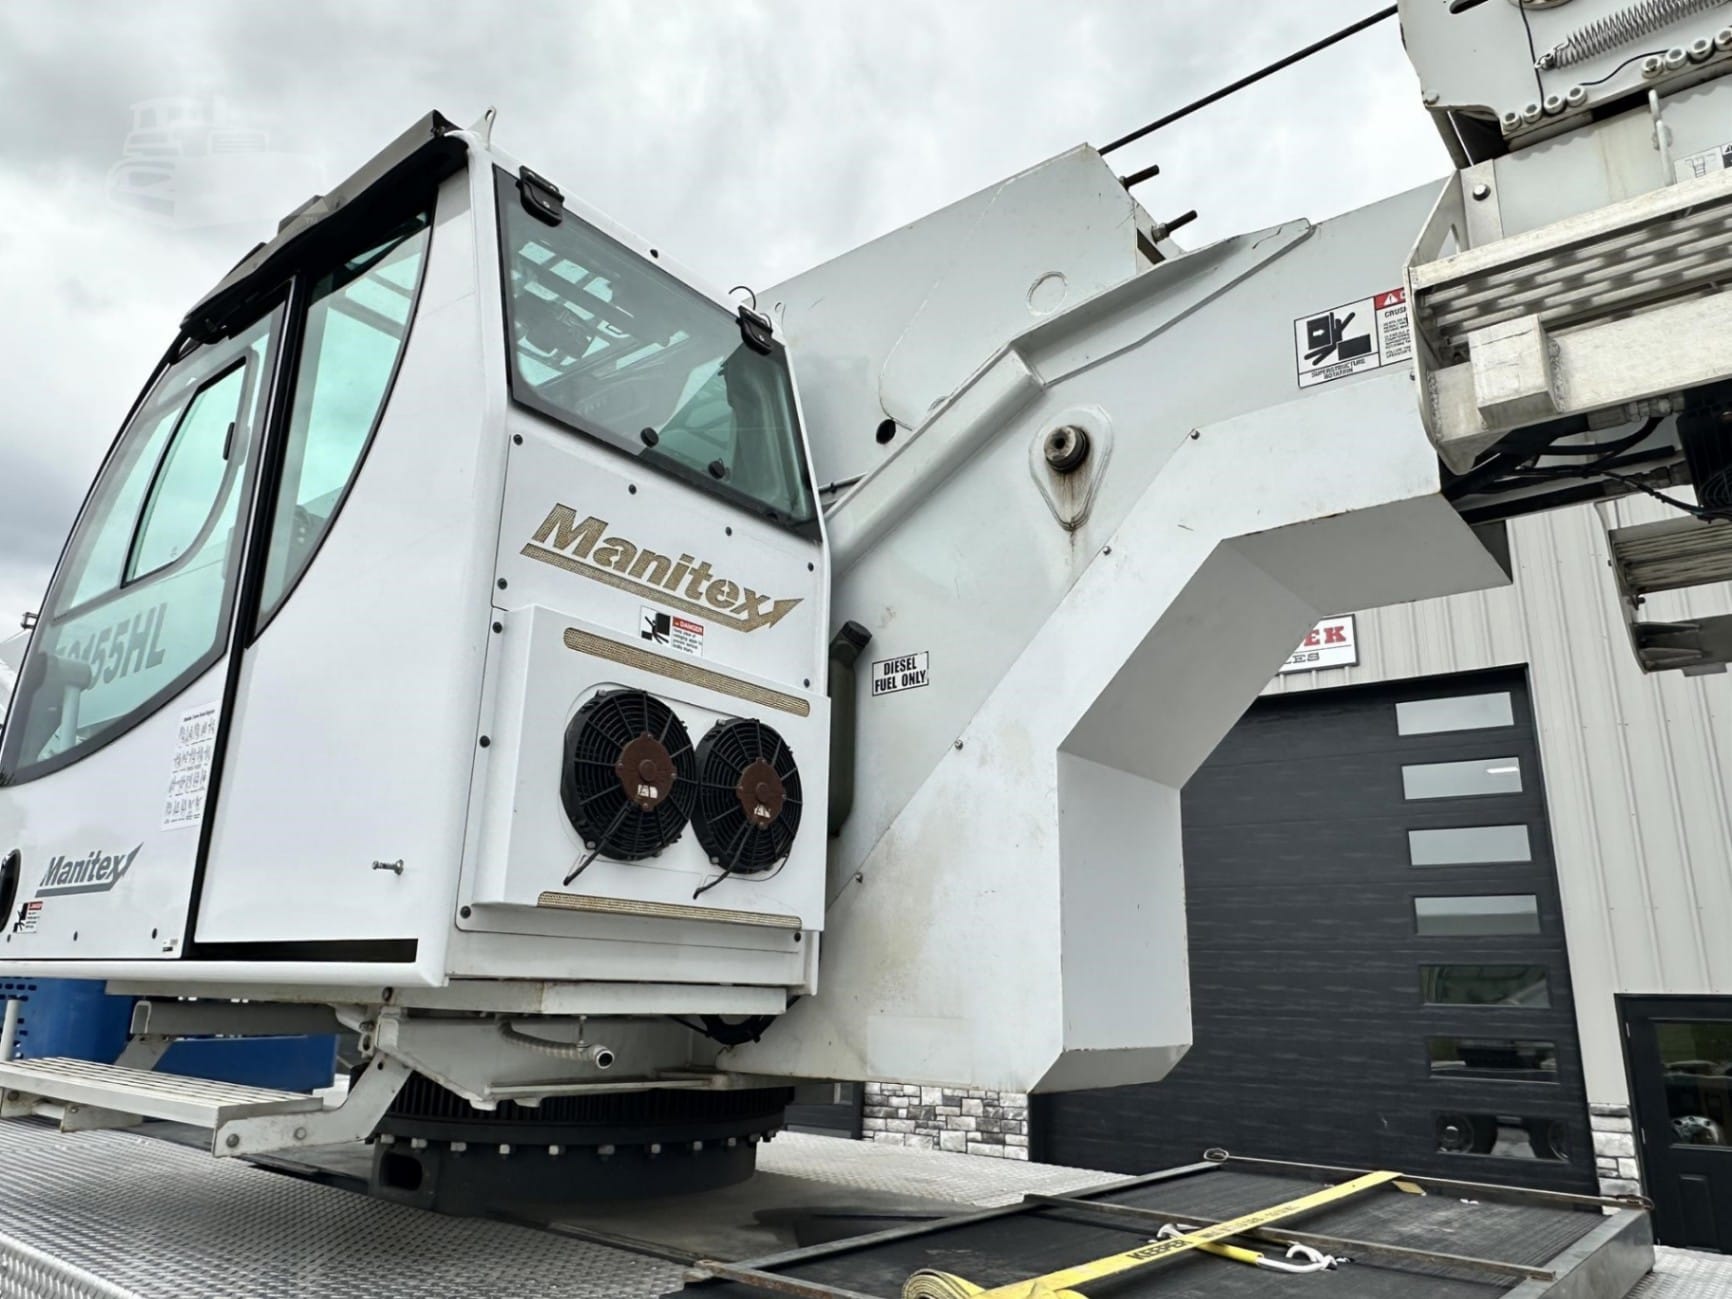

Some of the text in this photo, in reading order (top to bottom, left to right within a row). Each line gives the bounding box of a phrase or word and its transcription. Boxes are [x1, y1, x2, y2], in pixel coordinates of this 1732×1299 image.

[531, 502, 772, 620] Manitex
[875, 670, 926, 692] FUEL ONLY
[884, 656, 917, 676] DIESEL
[39, 849, 128, 888] Manitex
